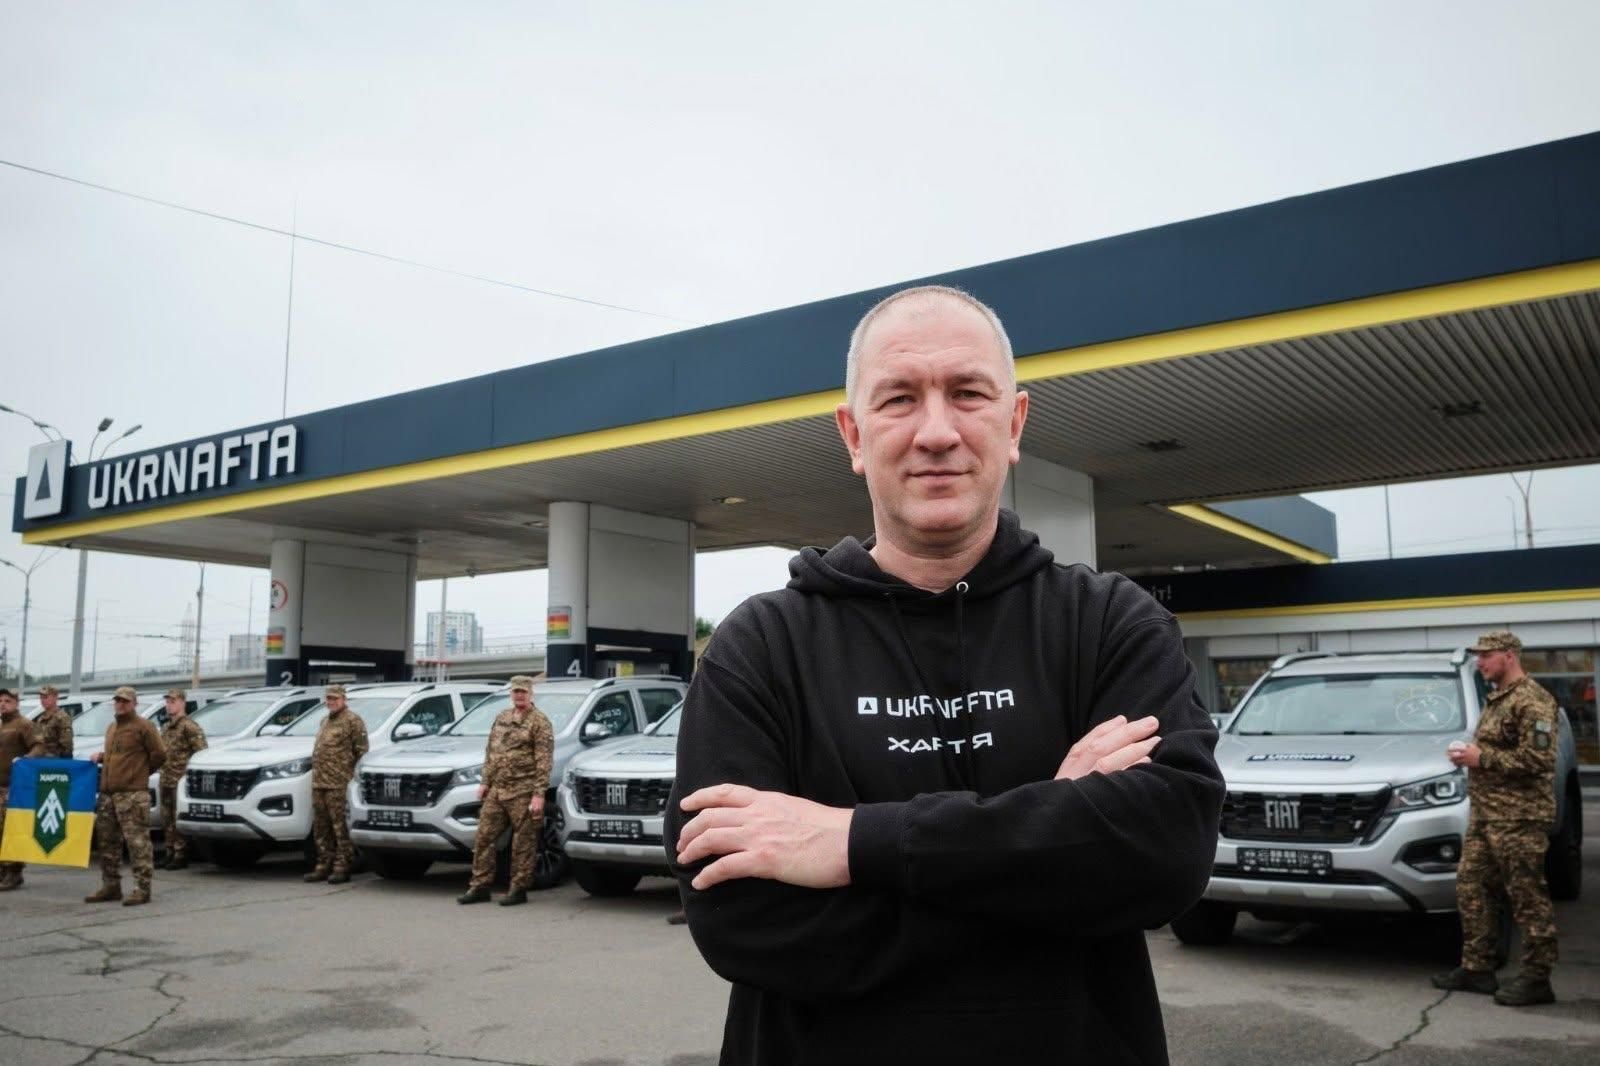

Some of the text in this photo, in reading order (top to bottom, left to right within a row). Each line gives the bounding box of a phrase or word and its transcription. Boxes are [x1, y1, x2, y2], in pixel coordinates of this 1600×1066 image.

[88, 424, 297, 509] UKRNAFTA
[280, 671, 293, 687] 2
[567, 659, 582, 678] 4
[887, 732, 993, 754] ХАРТЯ
[606, 784, 628, 805] FIAT
[1264, 800, 1300, 829] FIAT
